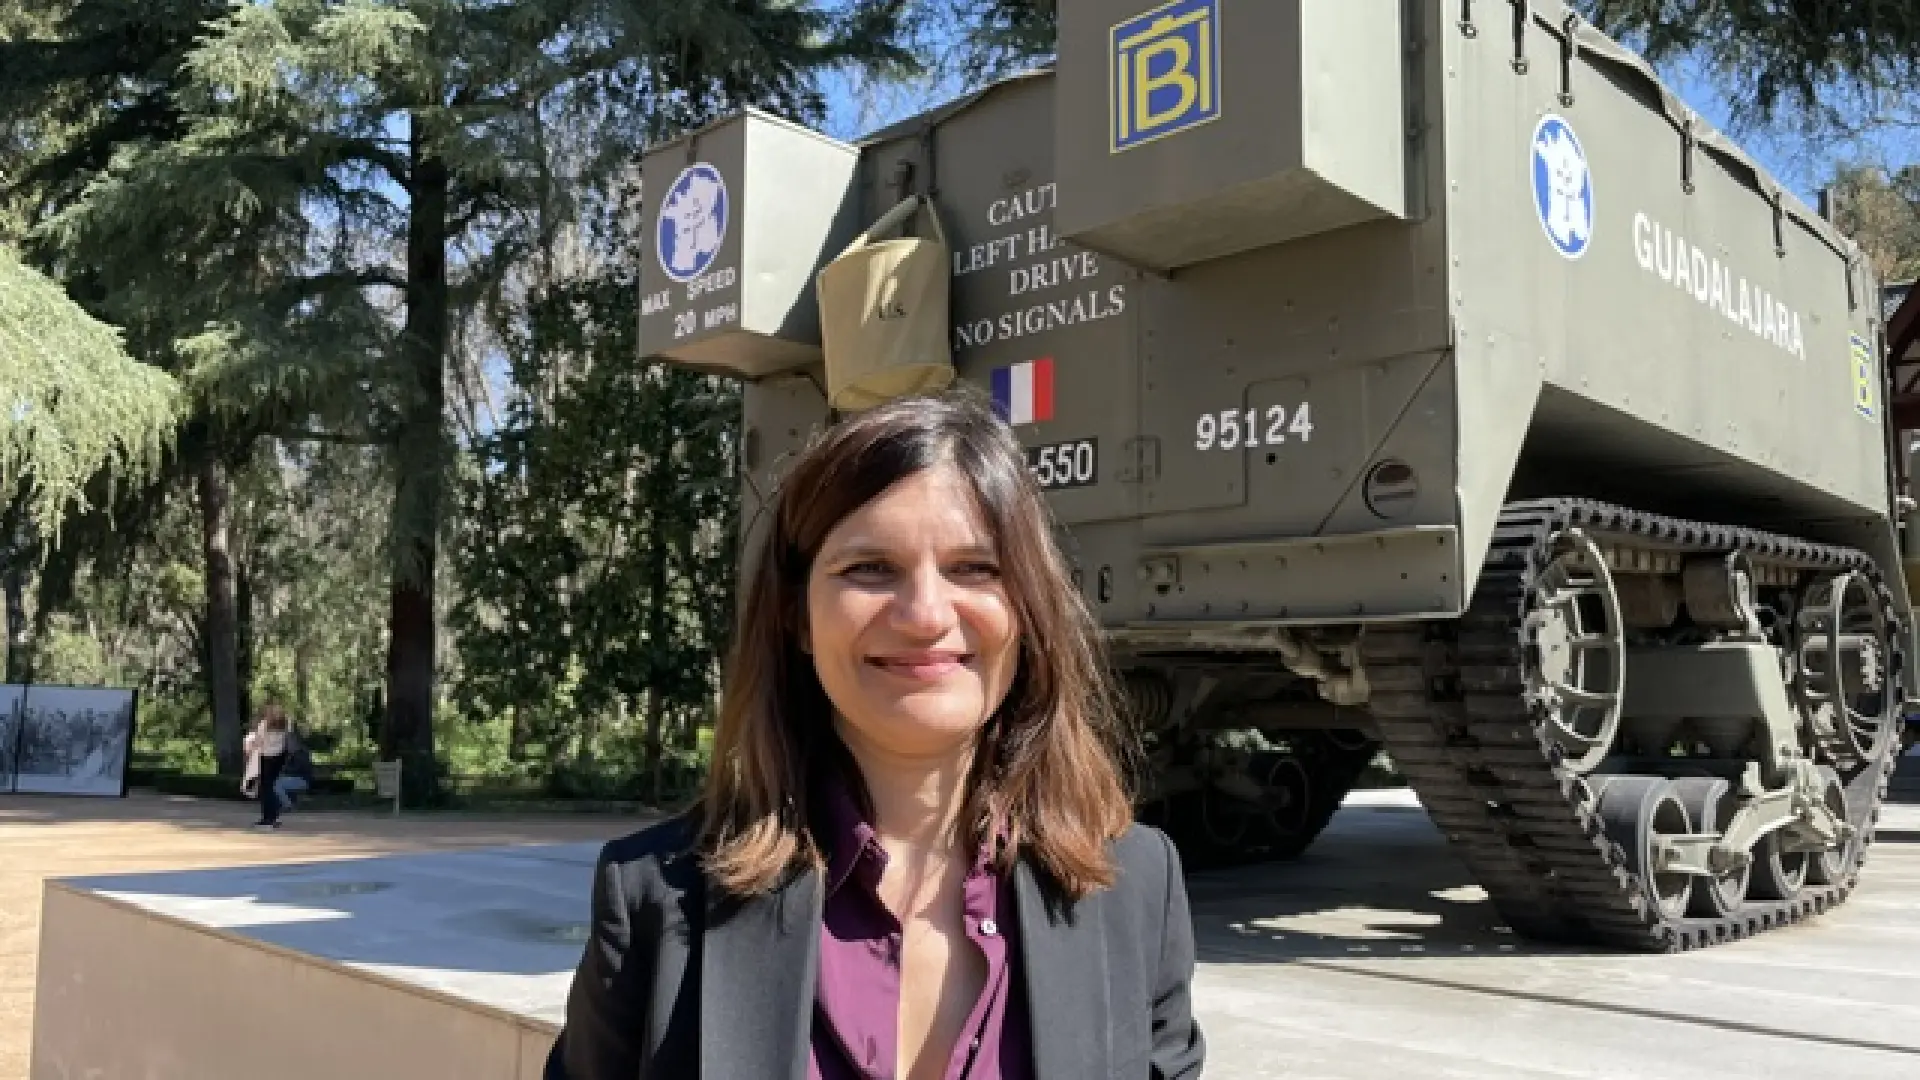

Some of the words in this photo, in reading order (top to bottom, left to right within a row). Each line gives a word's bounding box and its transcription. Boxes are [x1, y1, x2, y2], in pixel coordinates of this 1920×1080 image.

[953, 233, 1023, 276] LEFT
[1009, 252, 1099, 297] DRIVE
[641, 288, 670, 316] MAX
[686, 267, 736, 300] SPEED
[1632, 211, 1806, 361] GUADALAJARA
[674, 309, 697, 339] 20
[705, 303, 737, 330] MPH
[956, 318, 994, 348] NO
[998, 285, 1126, 339] SIGNALS
[1194, 402, 1315, 451] 95124
